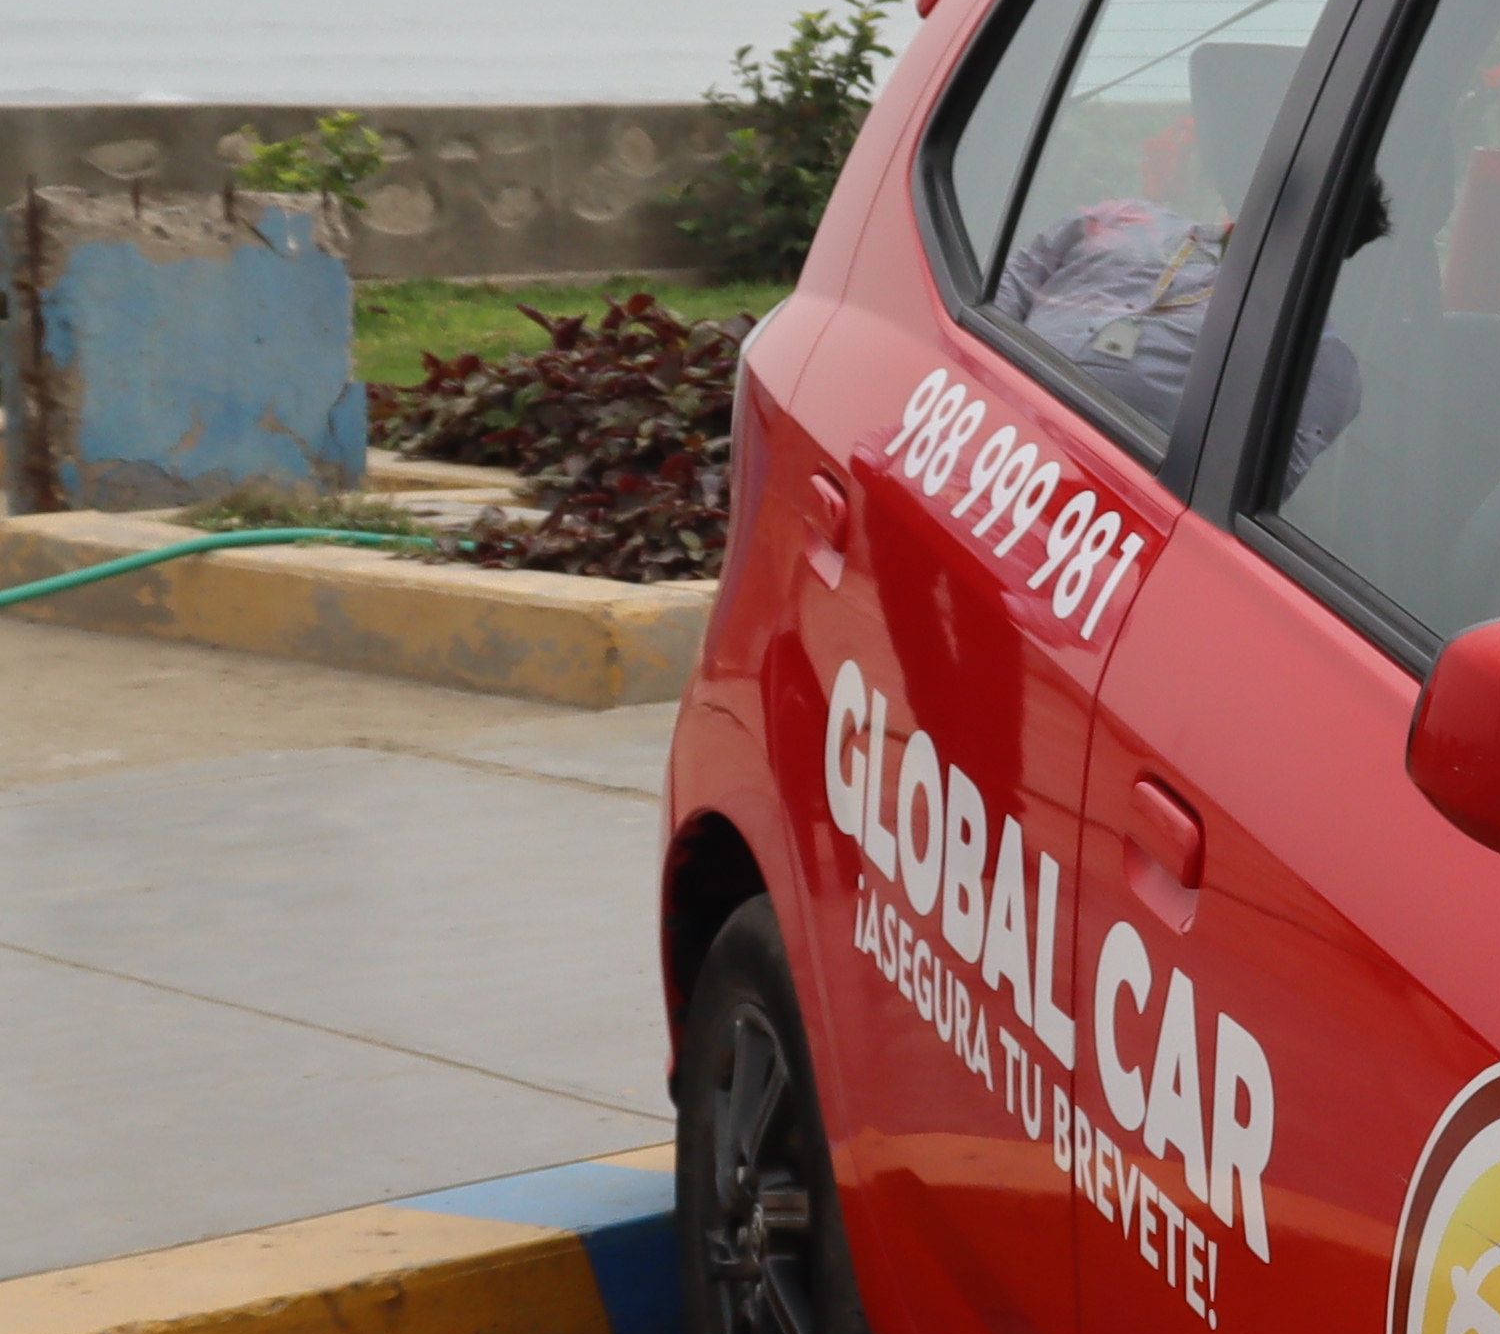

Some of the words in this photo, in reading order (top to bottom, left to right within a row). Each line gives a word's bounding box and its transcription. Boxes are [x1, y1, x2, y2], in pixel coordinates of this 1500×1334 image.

[884, 368, 986, 497] 988
[950, 425, 1061, 558] 999
[1026, 490, 1145, 641] 981
[824, 659, 1077, 1071] GLOBAL
[1094, 920, 1274, 1264] CAR
[853, 874, 994, 1094] ¡ASEGURA
[998, 1027, 1043, 1142] TU
[1053, 1080, 1221, 1331] BREVETE!
